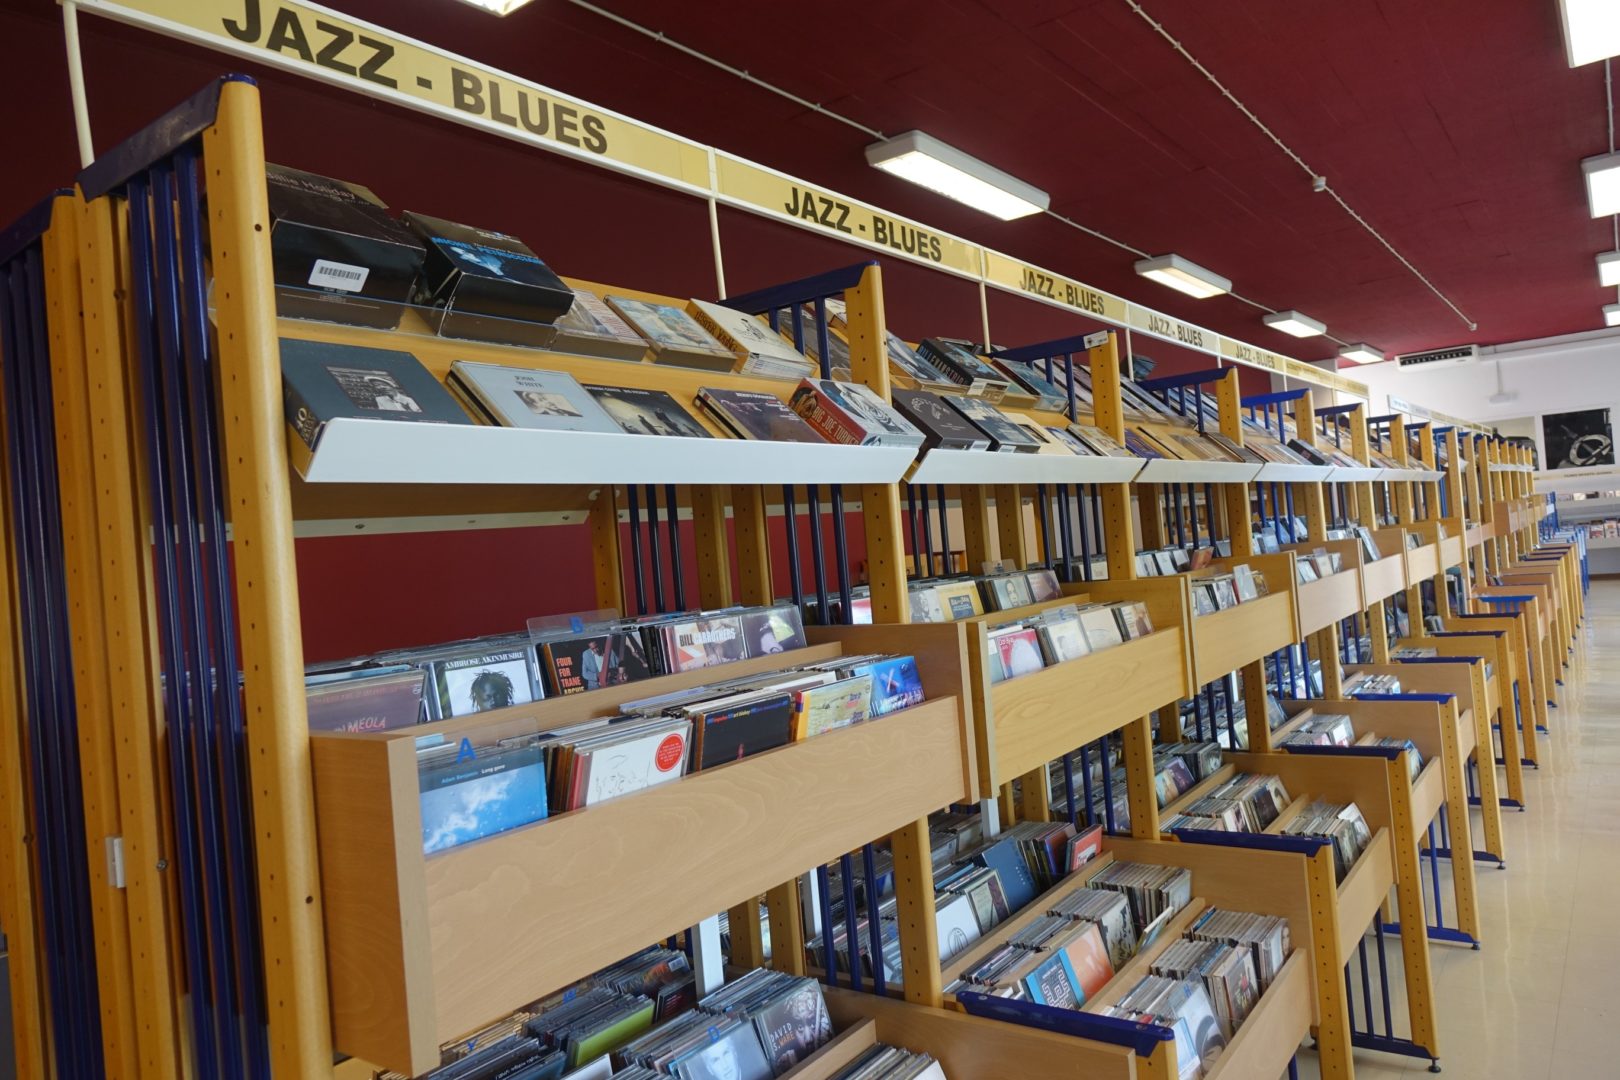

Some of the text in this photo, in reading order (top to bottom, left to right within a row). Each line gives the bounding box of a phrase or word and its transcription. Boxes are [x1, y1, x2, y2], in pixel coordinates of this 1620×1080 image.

[222, 0, 398, 90] JAZZ
[451, 67, 608, 154] BLUES
[784, 187, 852, 234] JAZZ
[872, 215, 942, 262] BLUES
[1019, 268, 1055, 299] JAZZ
[1065, 284, 1105, 316] BLUES
[1148, 314, 1170, 336] JAZZ
[1177, 324, 1203, 348] BLUES
[811, 406, 825, 423] BIG
[822, 416, 837, 434] JOE
[569, 616, 584, 634] B
[679, 628, 736, 647] BILL CARROTHERS
[444, 652, 525, 669] AMBROSE AKINMUSIRE
[556, 656, 573, 667] FOUR
[559, 668, 571, 677] FOR
[560, 677, 582, 689] TRANE
[456, 737, 477, 764] A
[707, 1026, 721, 1043] D
[770, 1022, 792, 1043] DAVID
